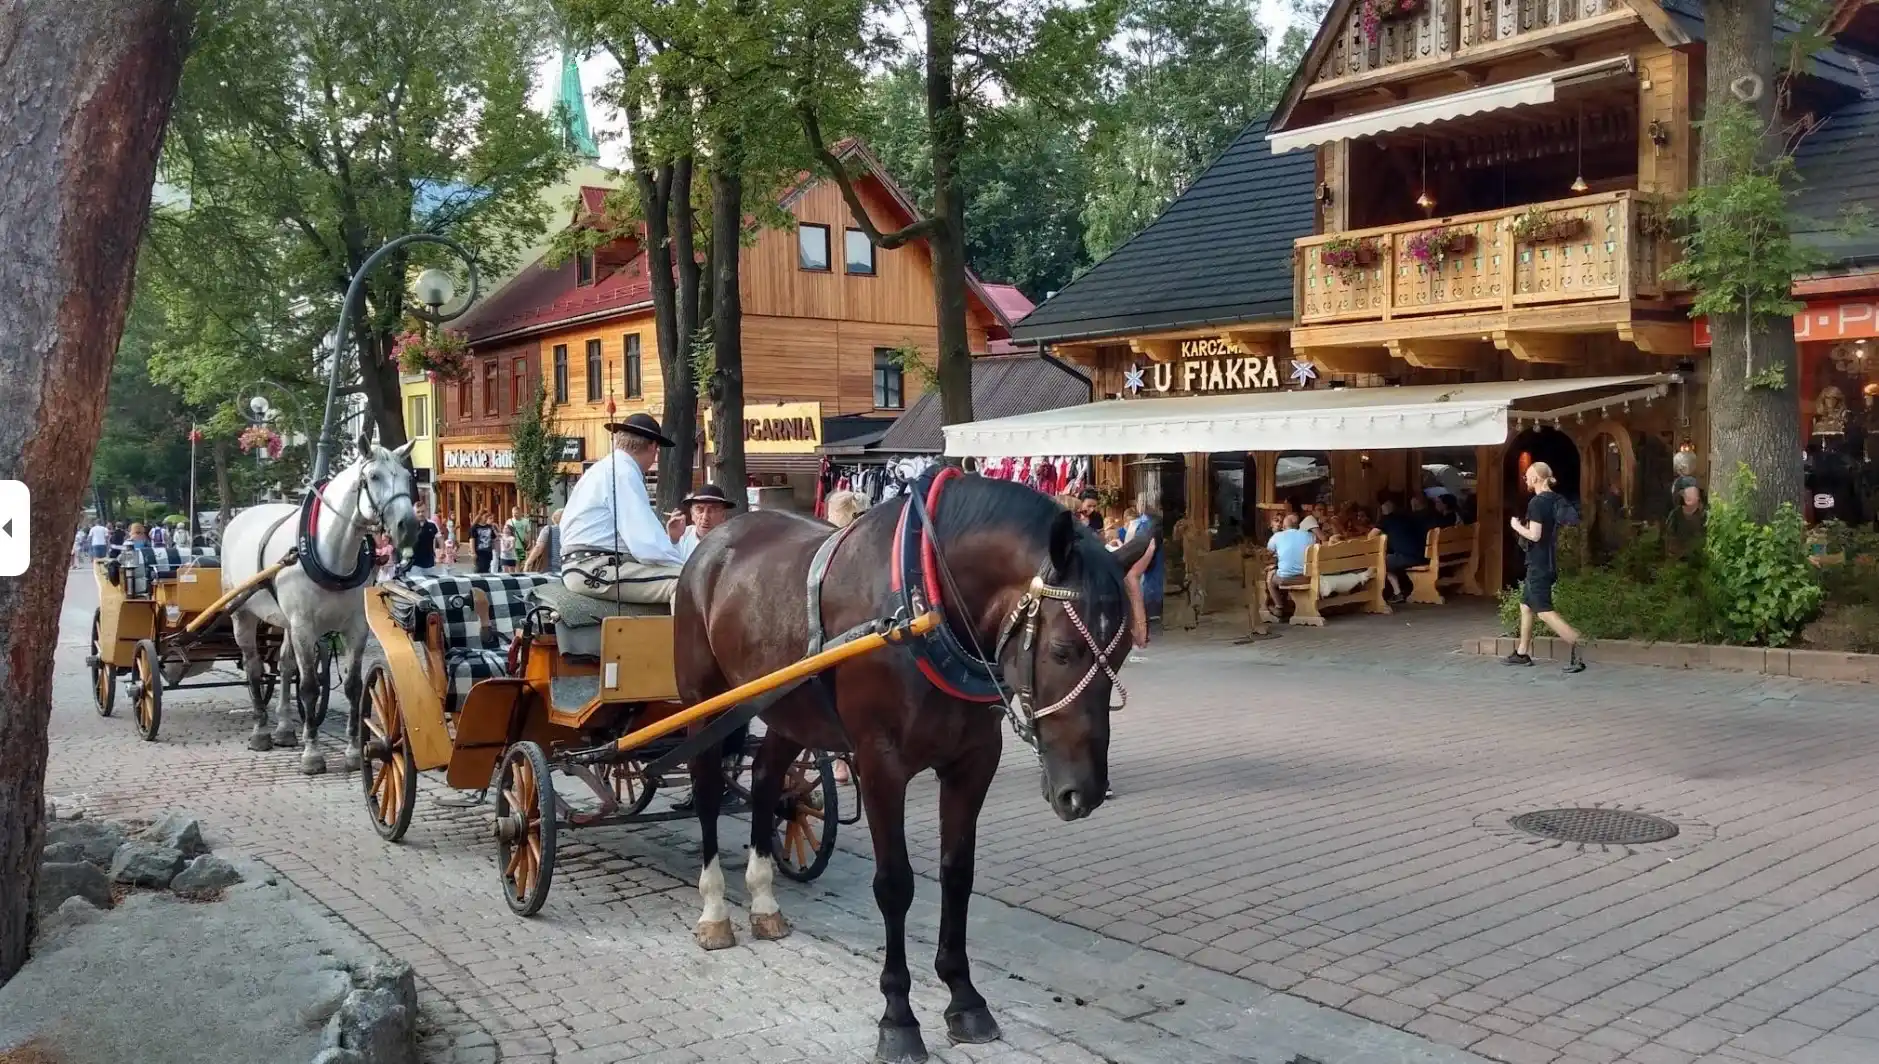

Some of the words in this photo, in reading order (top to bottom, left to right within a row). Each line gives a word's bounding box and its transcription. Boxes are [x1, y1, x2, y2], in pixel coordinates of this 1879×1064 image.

[1839, 303, 1879, 336] P
[1181, 339, 1242, 357] KARCZM
[1154, 362, 1171, 392] U
[1183, 355, 1279, 391] FIAKRA
